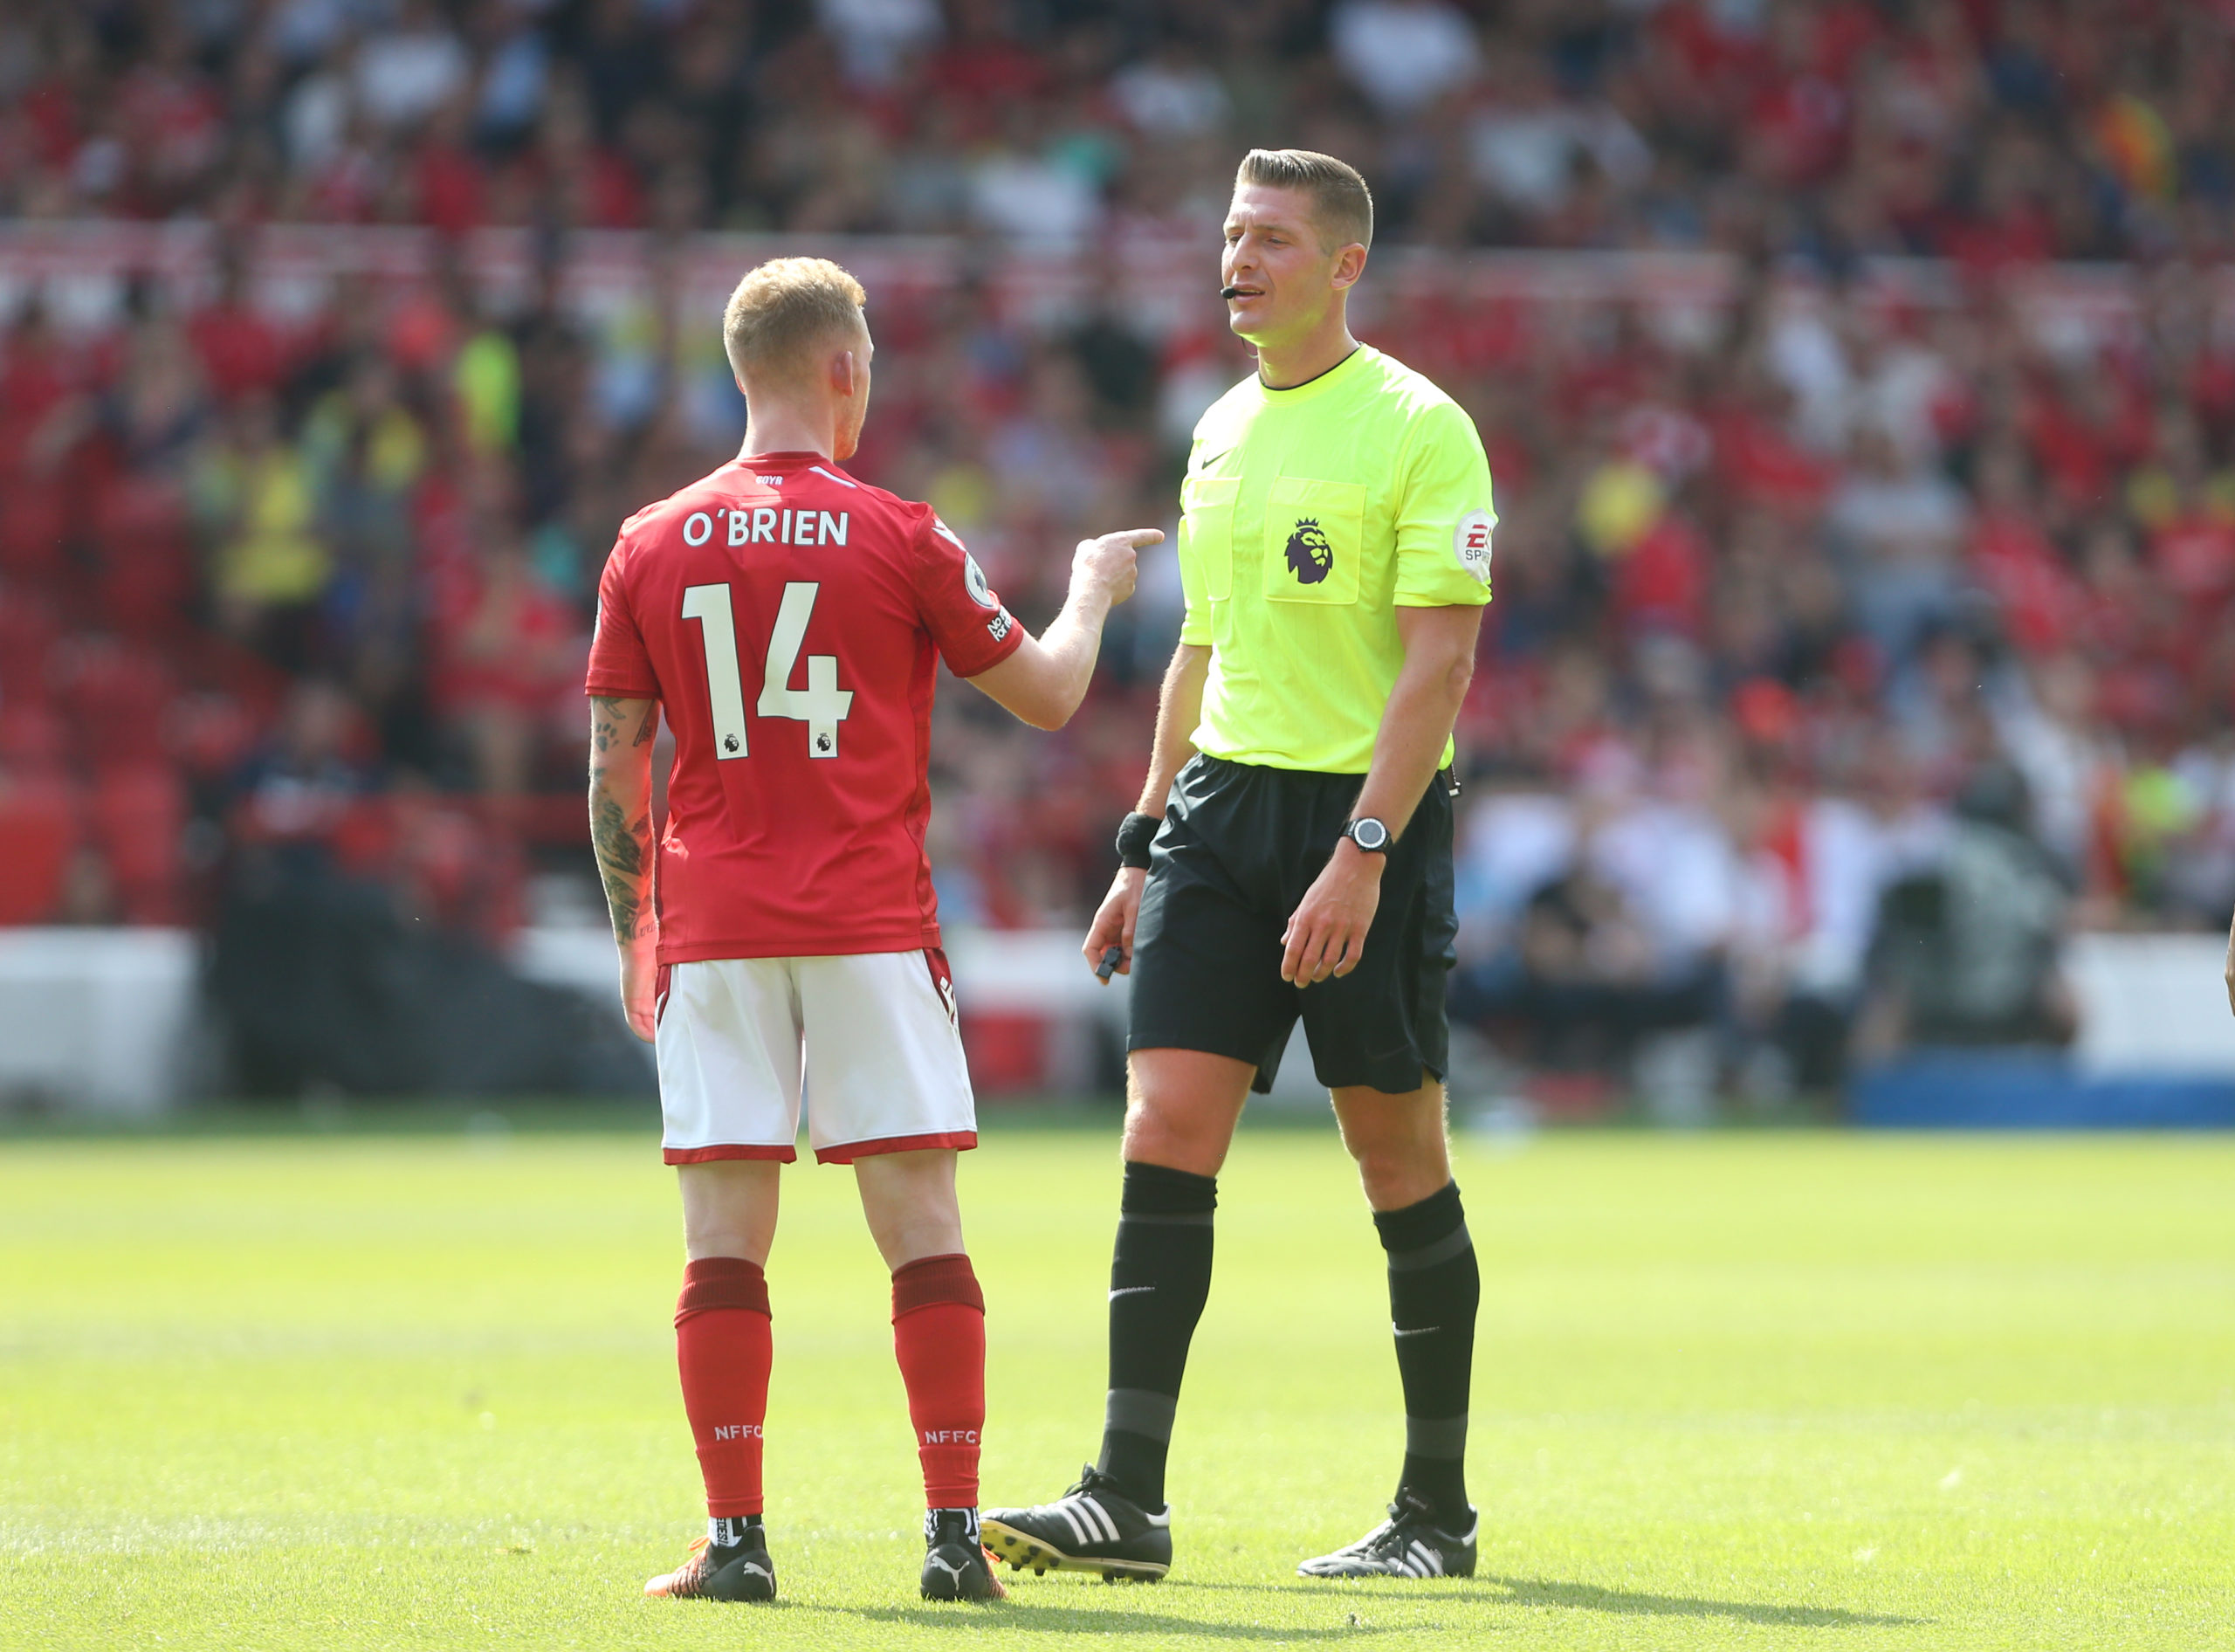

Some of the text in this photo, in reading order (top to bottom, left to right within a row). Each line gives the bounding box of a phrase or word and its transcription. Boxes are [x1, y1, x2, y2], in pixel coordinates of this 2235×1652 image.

[683, 507, 849, 547] O'BRIEN
[682, 581, 854, 761] 14
[713, 1424, 764, 1442] NFFC
[925, 1429, 977, 1444] NFFC
